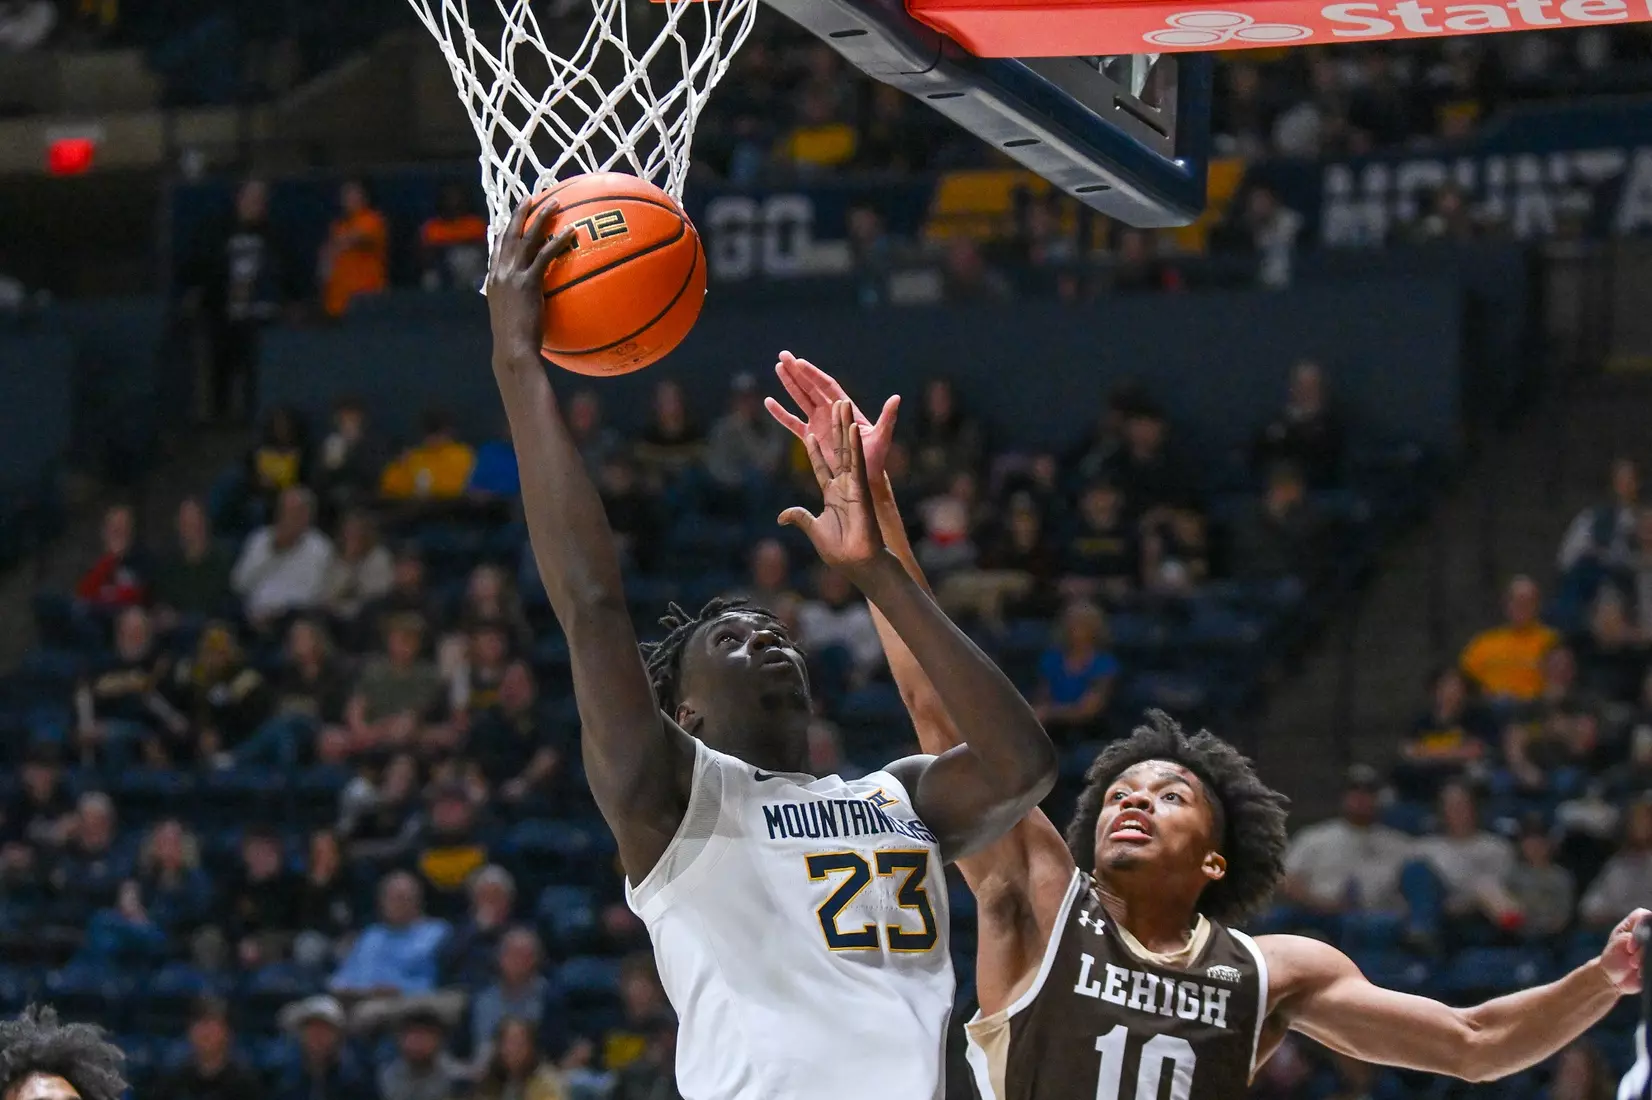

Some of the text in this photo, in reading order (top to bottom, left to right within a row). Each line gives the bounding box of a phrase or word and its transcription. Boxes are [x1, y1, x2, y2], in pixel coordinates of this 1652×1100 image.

[1321, 0, 1628, 37] State
[804, 850, 939, 952] 23
[1073, 952, 1232, 1029] LEHIGH
[1094, 1024, 1198, 1100] 10
